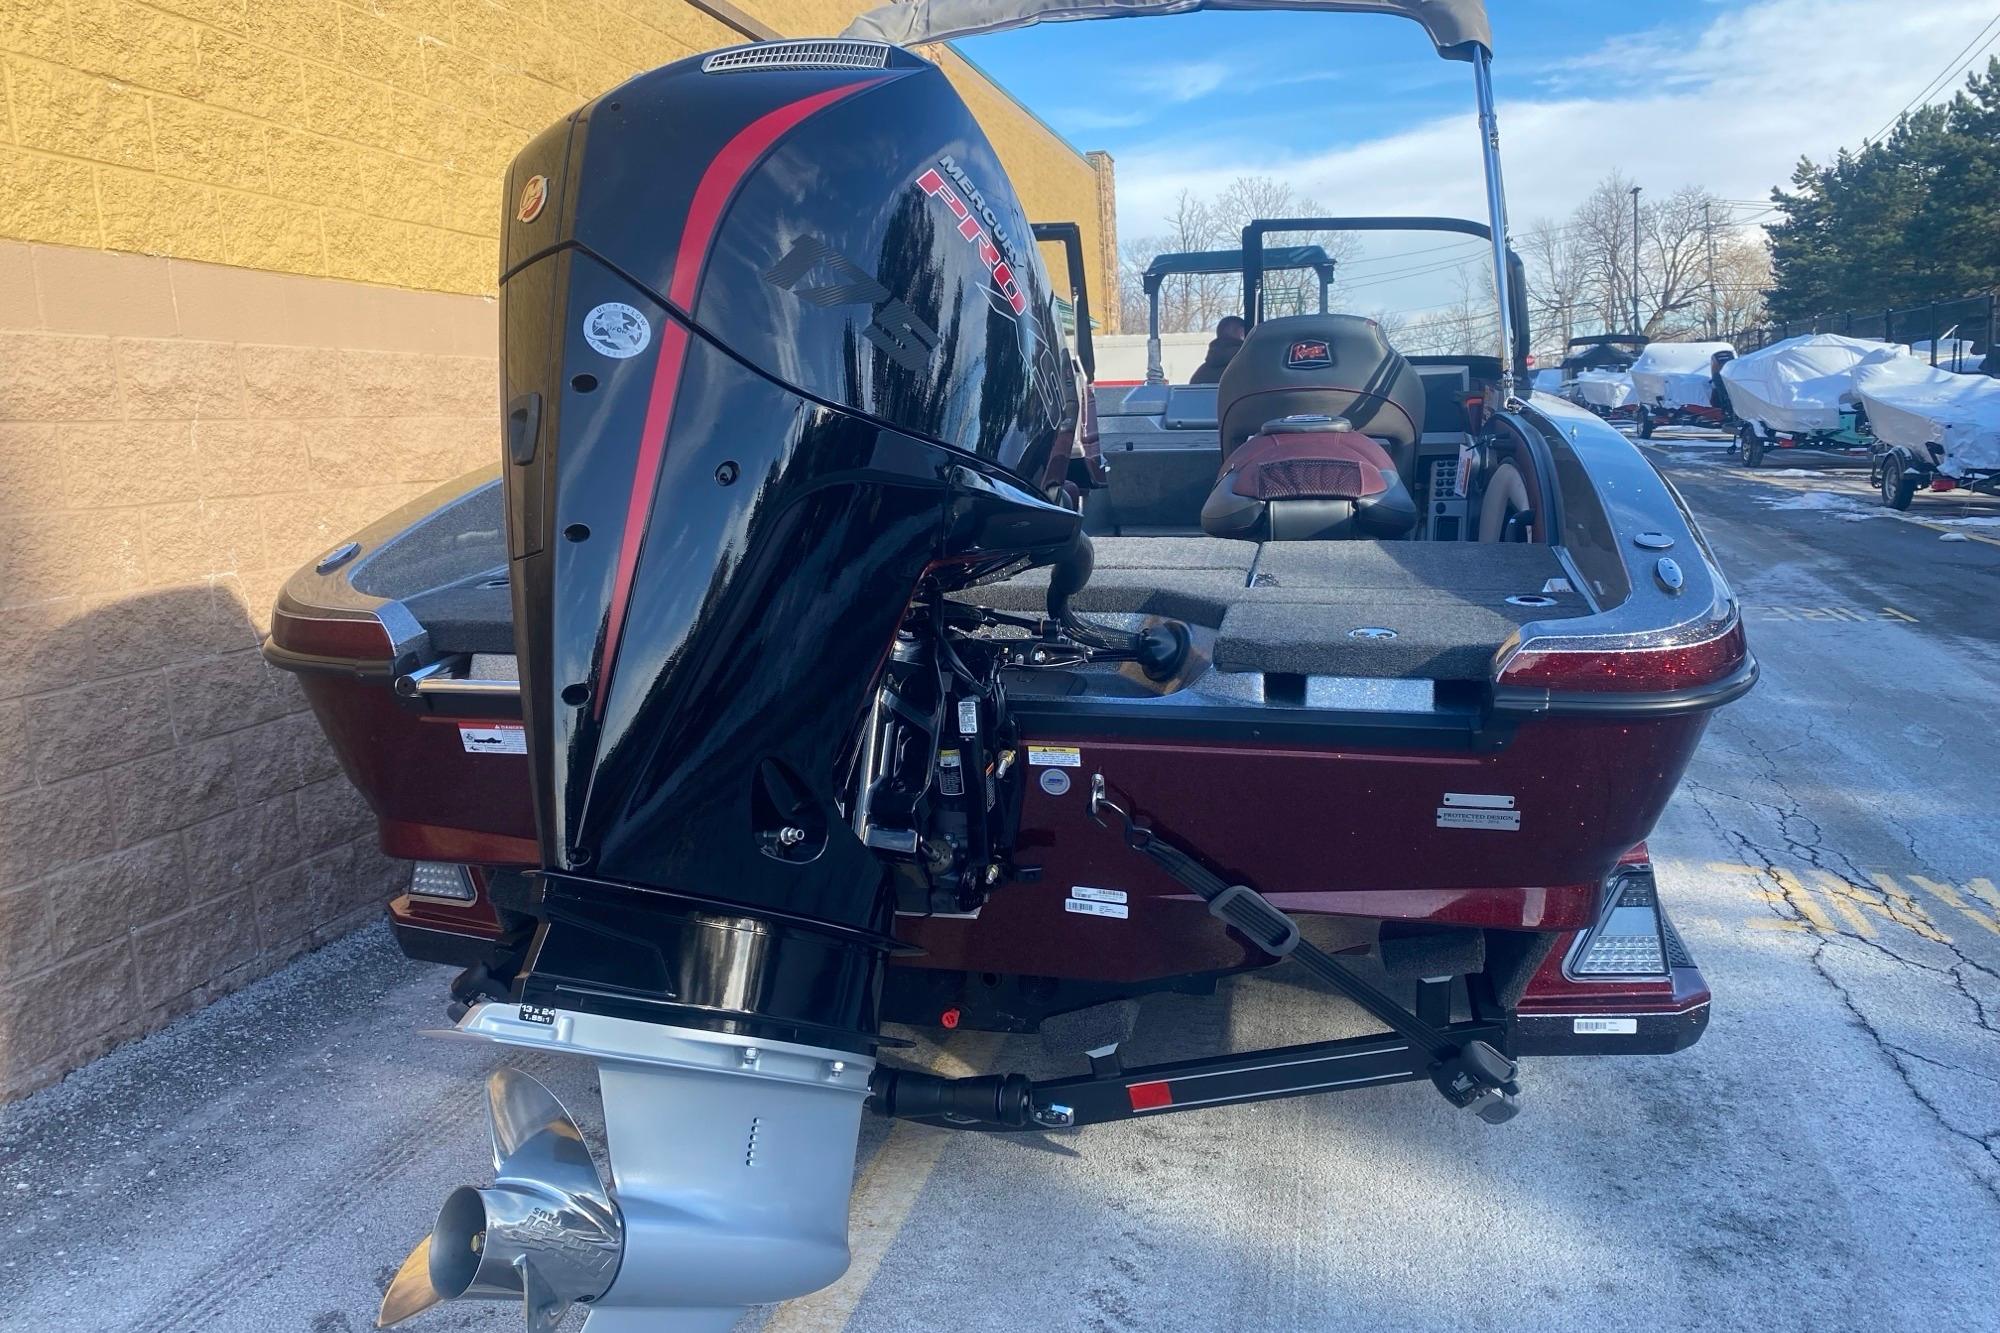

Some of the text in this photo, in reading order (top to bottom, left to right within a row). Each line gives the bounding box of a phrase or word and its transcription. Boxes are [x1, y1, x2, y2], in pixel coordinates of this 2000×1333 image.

[938, 155, 1024, 269] MERCURY
[915, 168, 1027, 316] PRO
[1443, 812, 1486, 820] PROTECTED
[521, 1004, 533, 1013] 13
[541, 1008, 555, 1017] 24
[524, 1013, 551, 1023] 1.85:1
